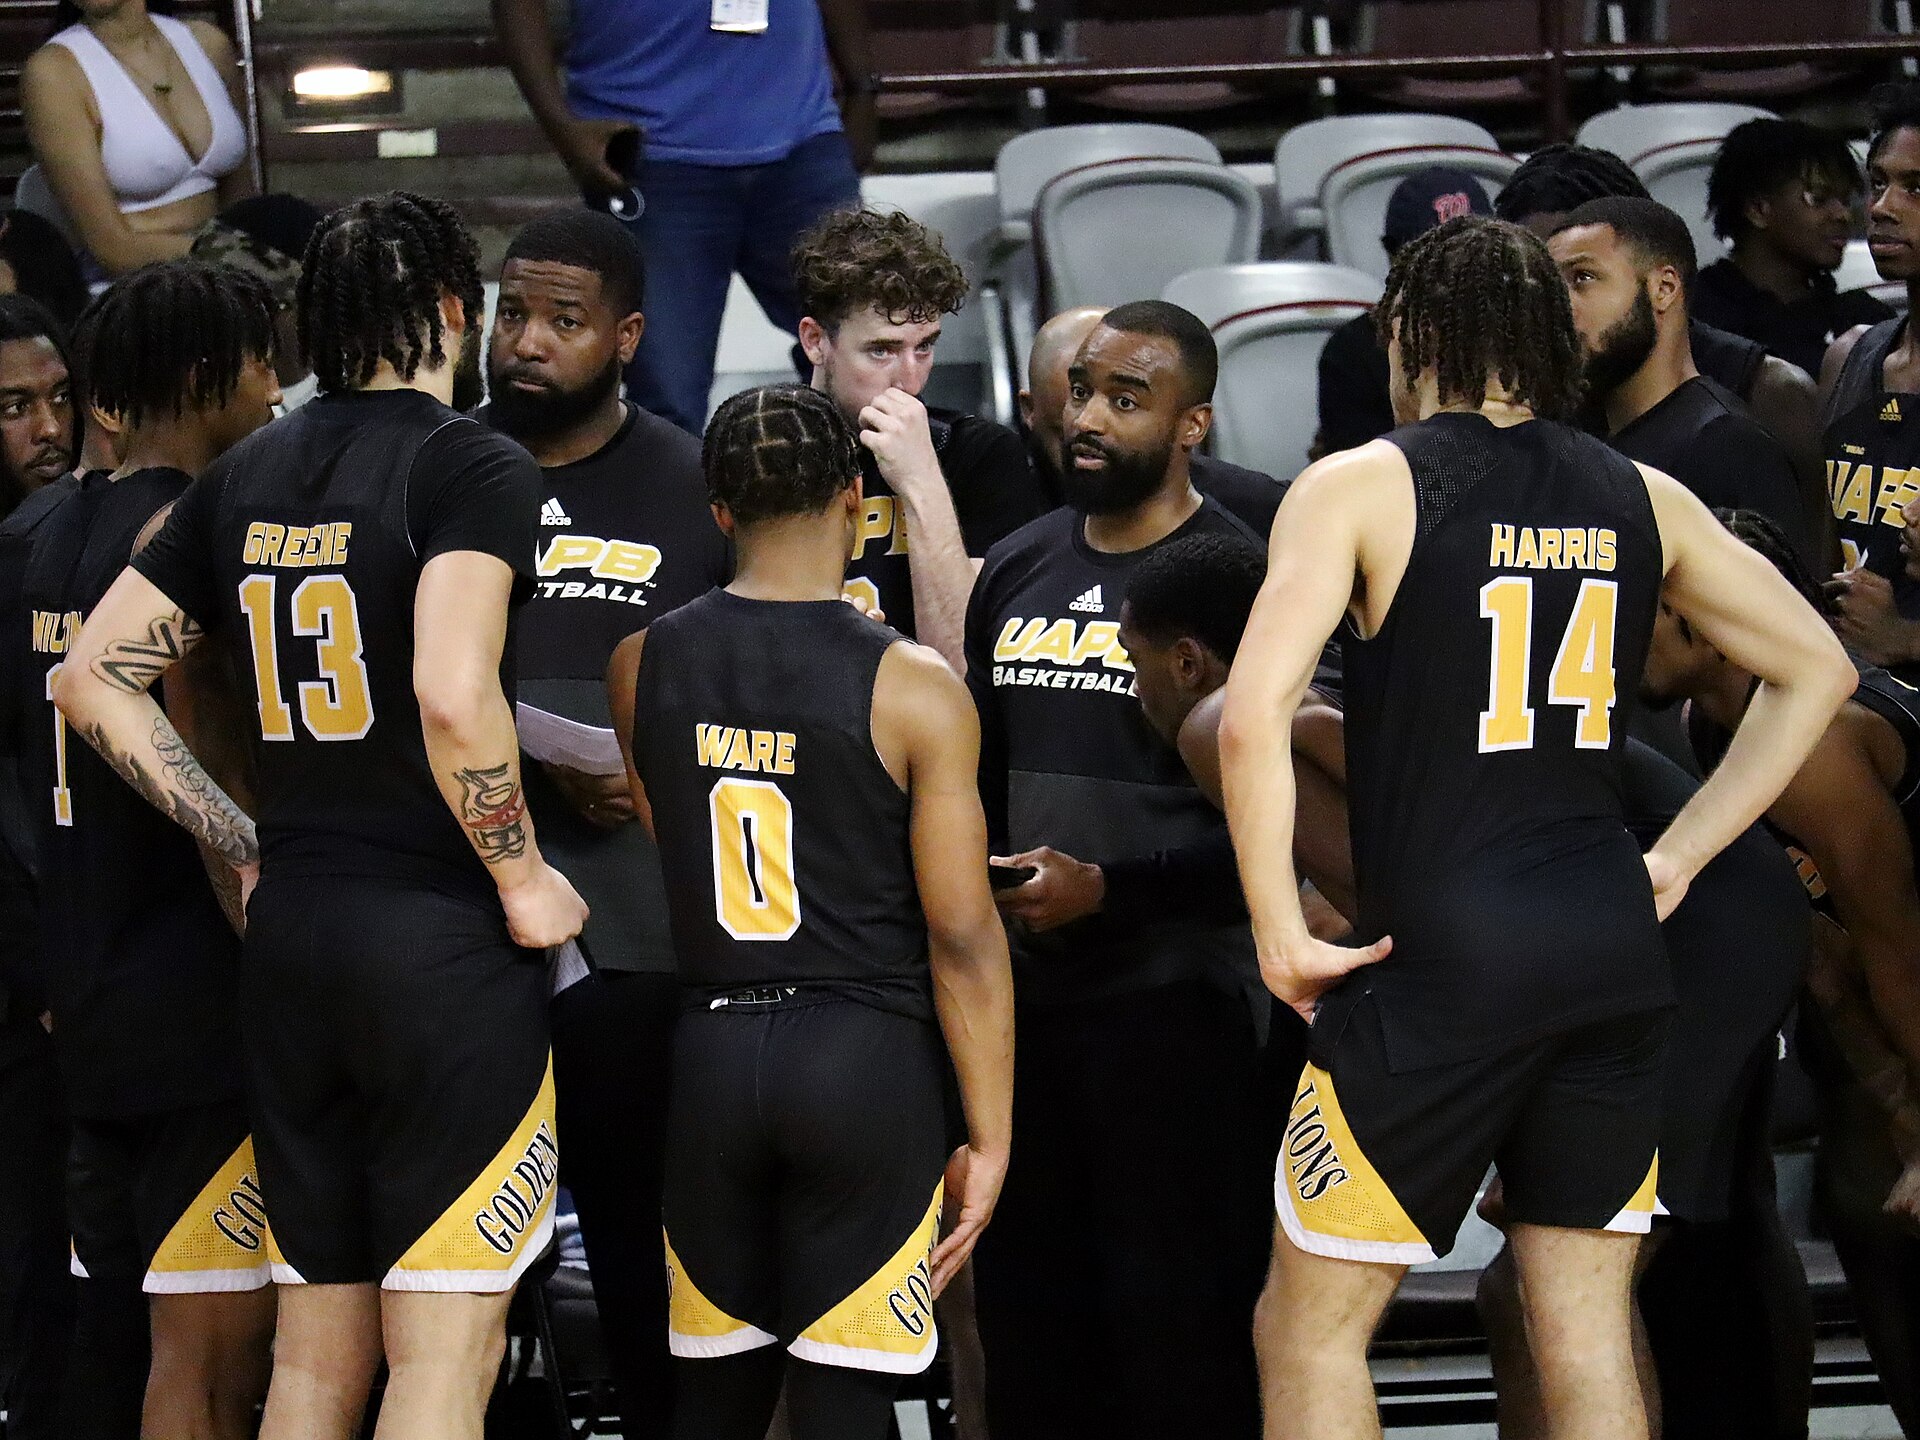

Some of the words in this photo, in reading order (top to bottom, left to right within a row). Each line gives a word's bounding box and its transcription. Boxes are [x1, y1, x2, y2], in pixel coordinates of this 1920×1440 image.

[243, 521, 352, 567] GREENE
[535, 534, 662, 584] PB
[1490, 523, 1617, 571] HARRIS
[533, 582, 648, 606] TBALL
[1069, 601, 1104, 613] adidas
[238, 574, 375, 741] 13
[1478, 576, 1618, 753] 14
[696, 723, 796, 775] WARE
[709, 776, 801, 941] 0
[475, 1119, 559, 1255] GOLDEN
